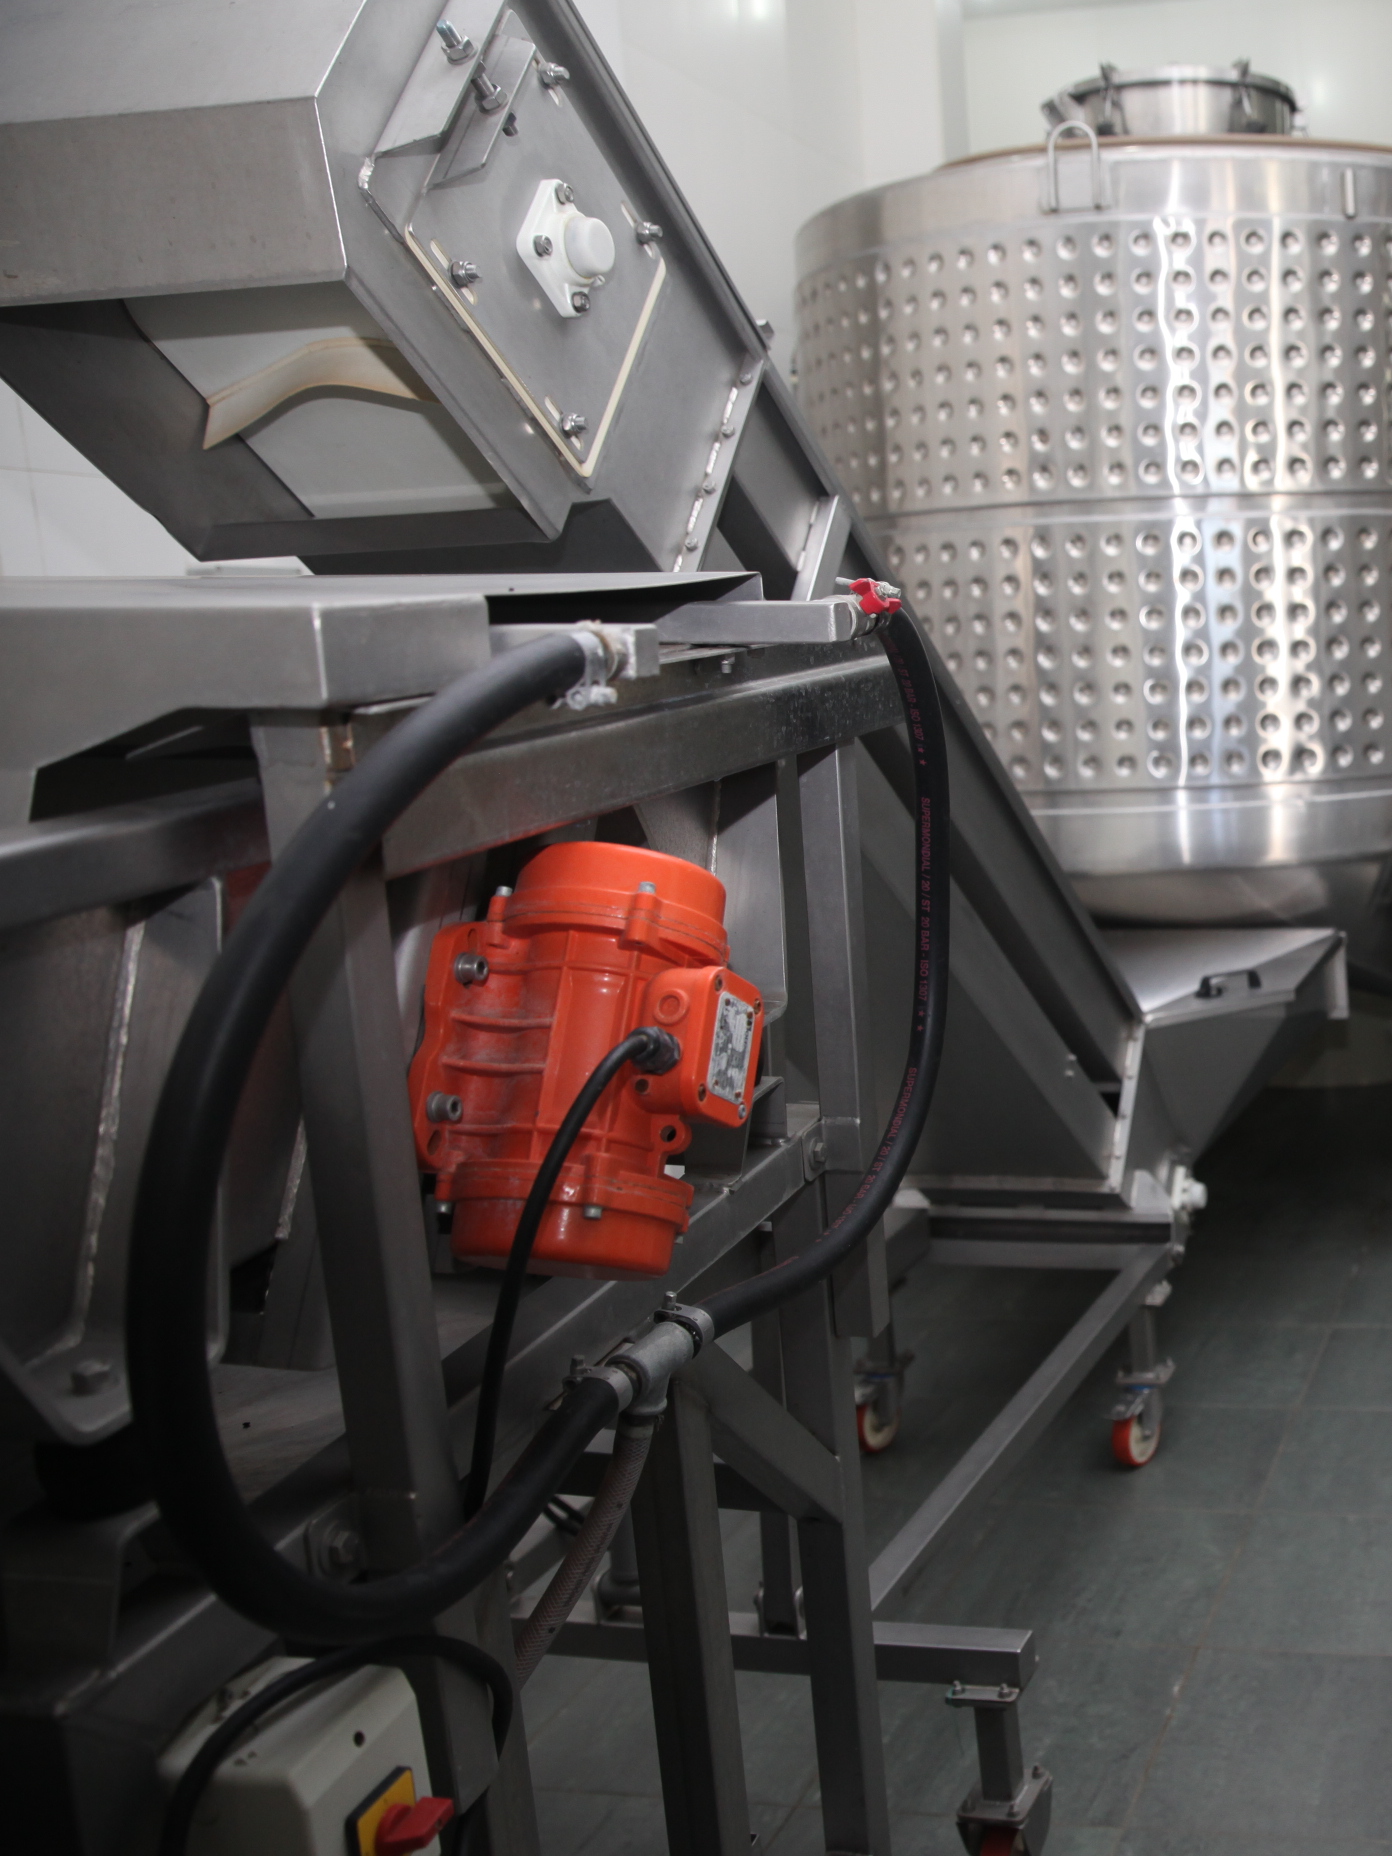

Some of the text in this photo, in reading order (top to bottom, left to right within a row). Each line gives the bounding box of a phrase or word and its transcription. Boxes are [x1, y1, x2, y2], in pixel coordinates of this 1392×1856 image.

[912, 723, 925, 740] 1307
[921, 797, 931, 872] SUPERMONDIAL
[921, 880, 930, 891] 20
[921, 899, 930, 912] ST
[921, 916, 930, 928] 20
[920, 930, 930, 951] BAR
[919, 960, 929, 977] ISO
[918, 980, 928, 1001] 1307
[887, 1067, 918, 1138] SUPERMONDIAL
[879, 1147, 890, 1156] 20
[872, 1162, 883, 1172] ST
